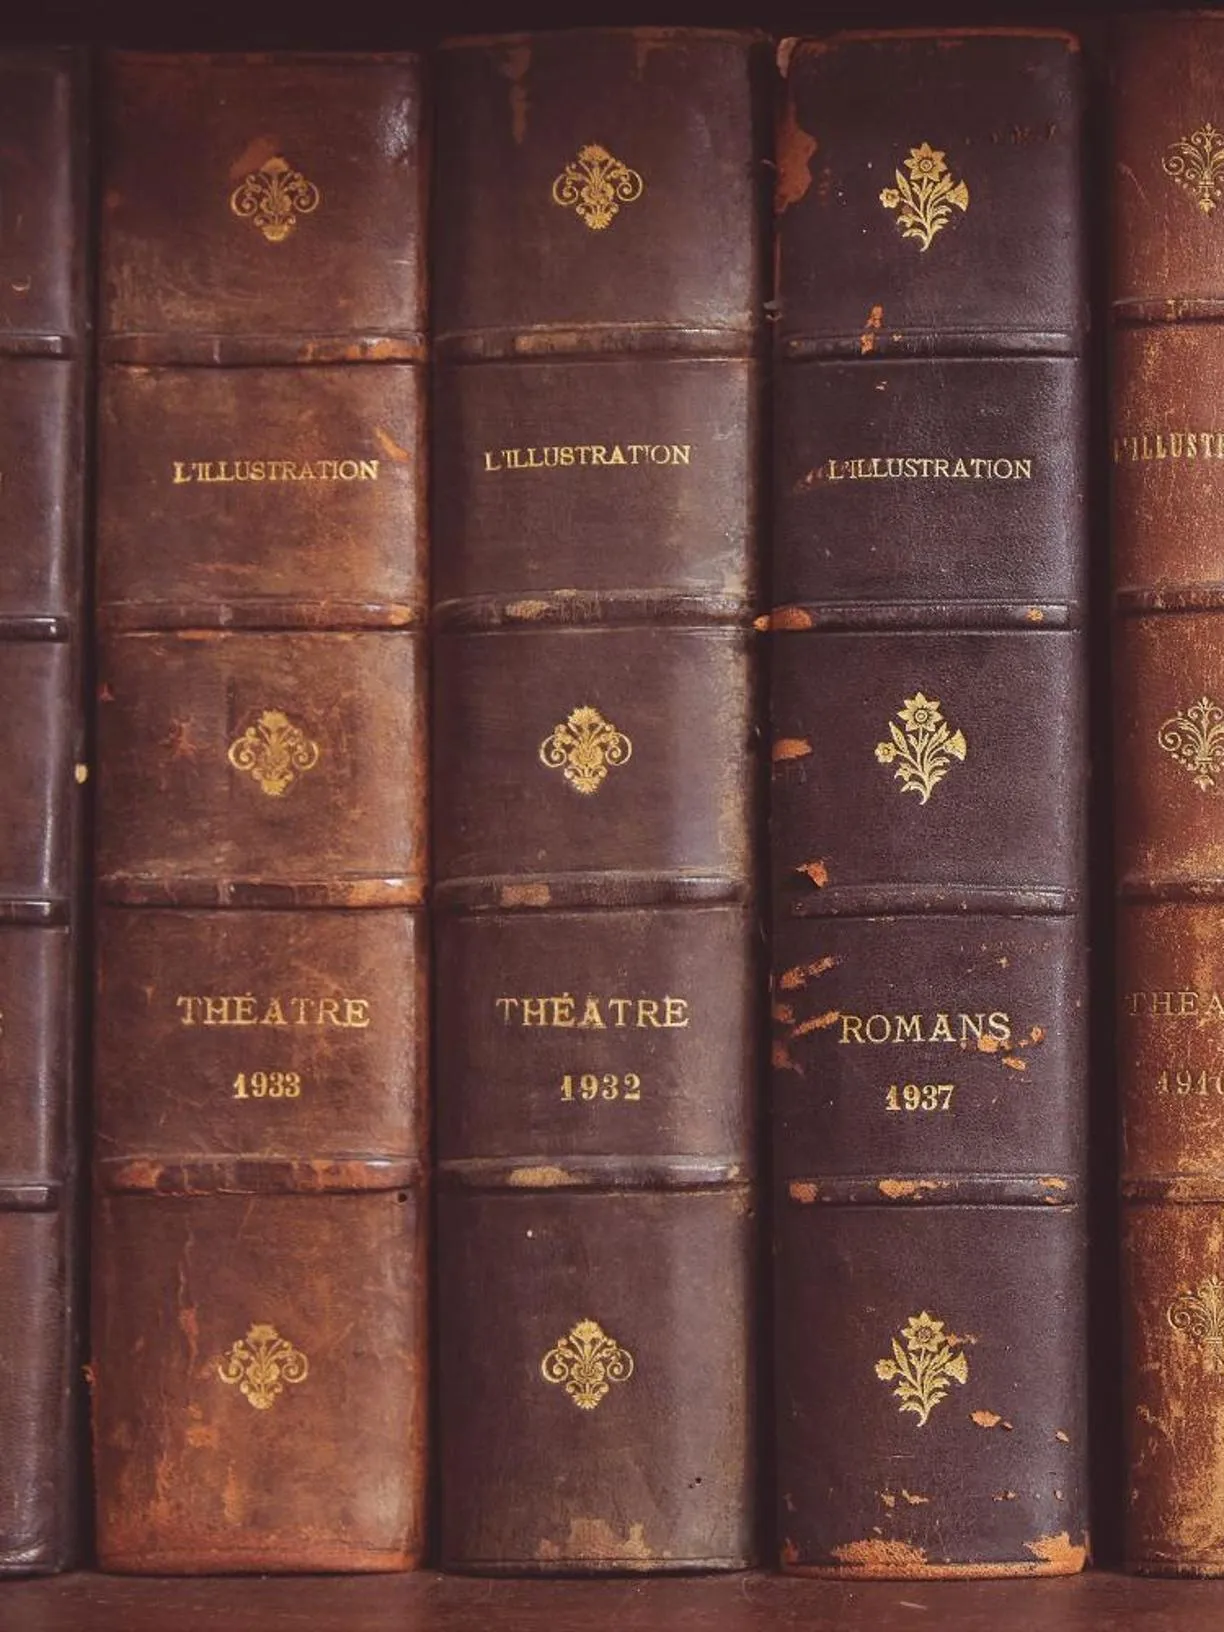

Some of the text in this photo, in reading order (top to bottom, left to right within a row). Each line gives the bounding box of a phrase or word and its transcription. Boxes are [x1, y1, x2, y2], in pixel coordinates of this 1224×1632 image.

[484, 443, 691, 471] L'ILLUSTRATION
[828, 457, 1032, 480] L'ILLUSTRATION
[173, 458, 379, 484] L'ILLUSTRATION
[838, 1011, 1012, 1044] ROMANS
[233, 1072, 301, 1099] 1933
[561, 1073, 641, 1101] 1932
[885, 1084, 955, 1111] 1937
